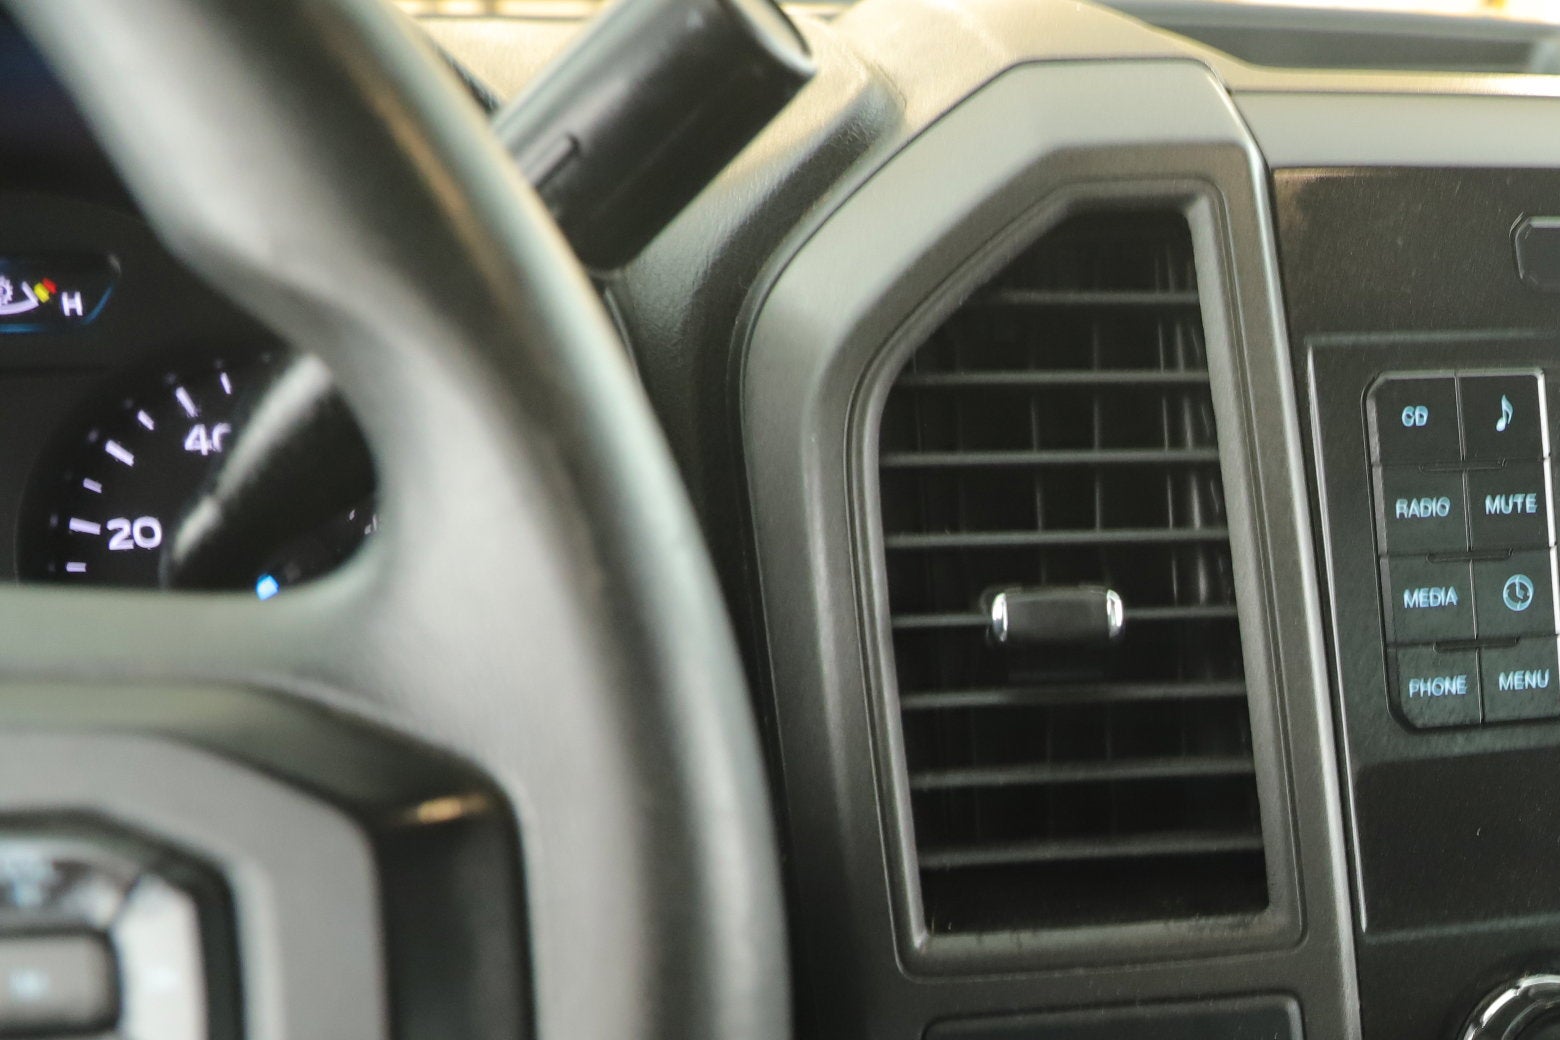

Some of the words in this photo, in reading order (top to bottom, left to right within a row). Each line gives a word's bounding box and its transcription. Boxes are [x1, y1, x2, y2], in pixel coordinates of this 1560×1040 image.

[60, 290, 83, 317] H
[1401, 405, 1429, 427] CD
[1396, 496, 1451, 519] RADIO
[1485, 493, 1538, 515] MUTE
[107, 516, 162, 551] 20
[1403, 586, 1458, 609] MEDIA
[1408, 674, 1468, 698] PHONE
[1498, 669, 1550, 691] MENU
